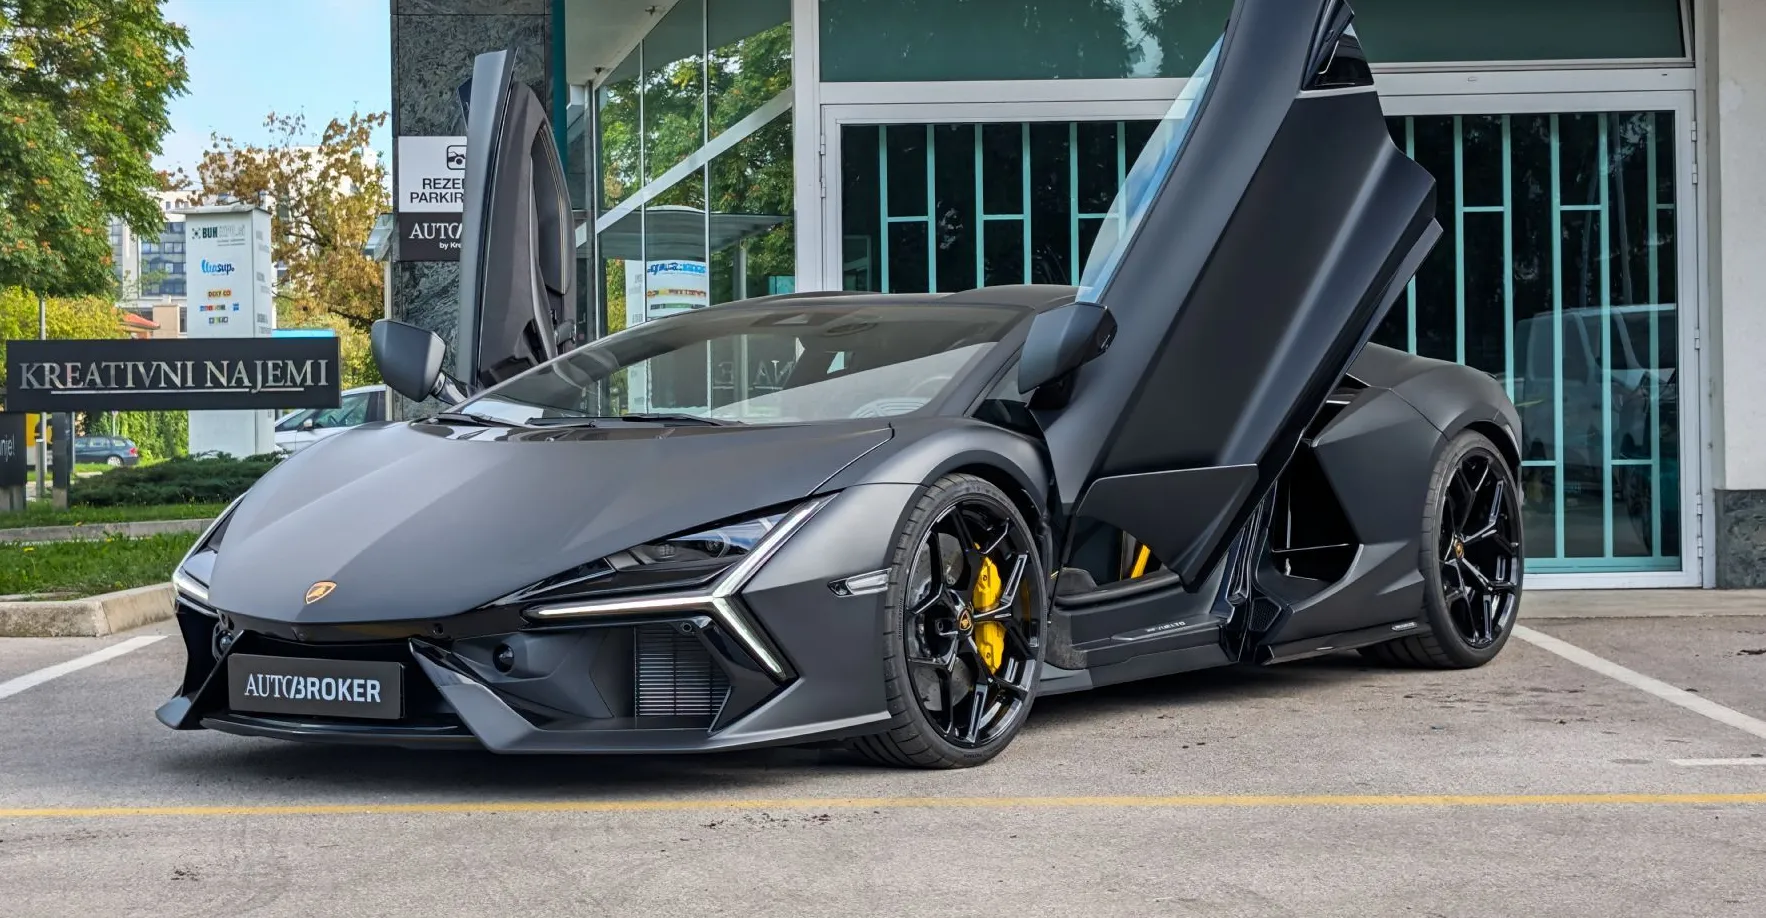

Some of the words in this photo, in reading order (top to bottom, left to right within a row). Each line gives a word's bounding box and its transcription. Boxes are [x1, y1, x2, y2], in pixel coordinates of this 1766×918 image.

[422, 178, 465, 190] REZE
[439, 242, 449, 251] by
[19, 360, 196, 390] KREATIVNI
[204, 359, 329, 393] NAJEMI
[244, 673, 381, 703] AUTOBROKER
